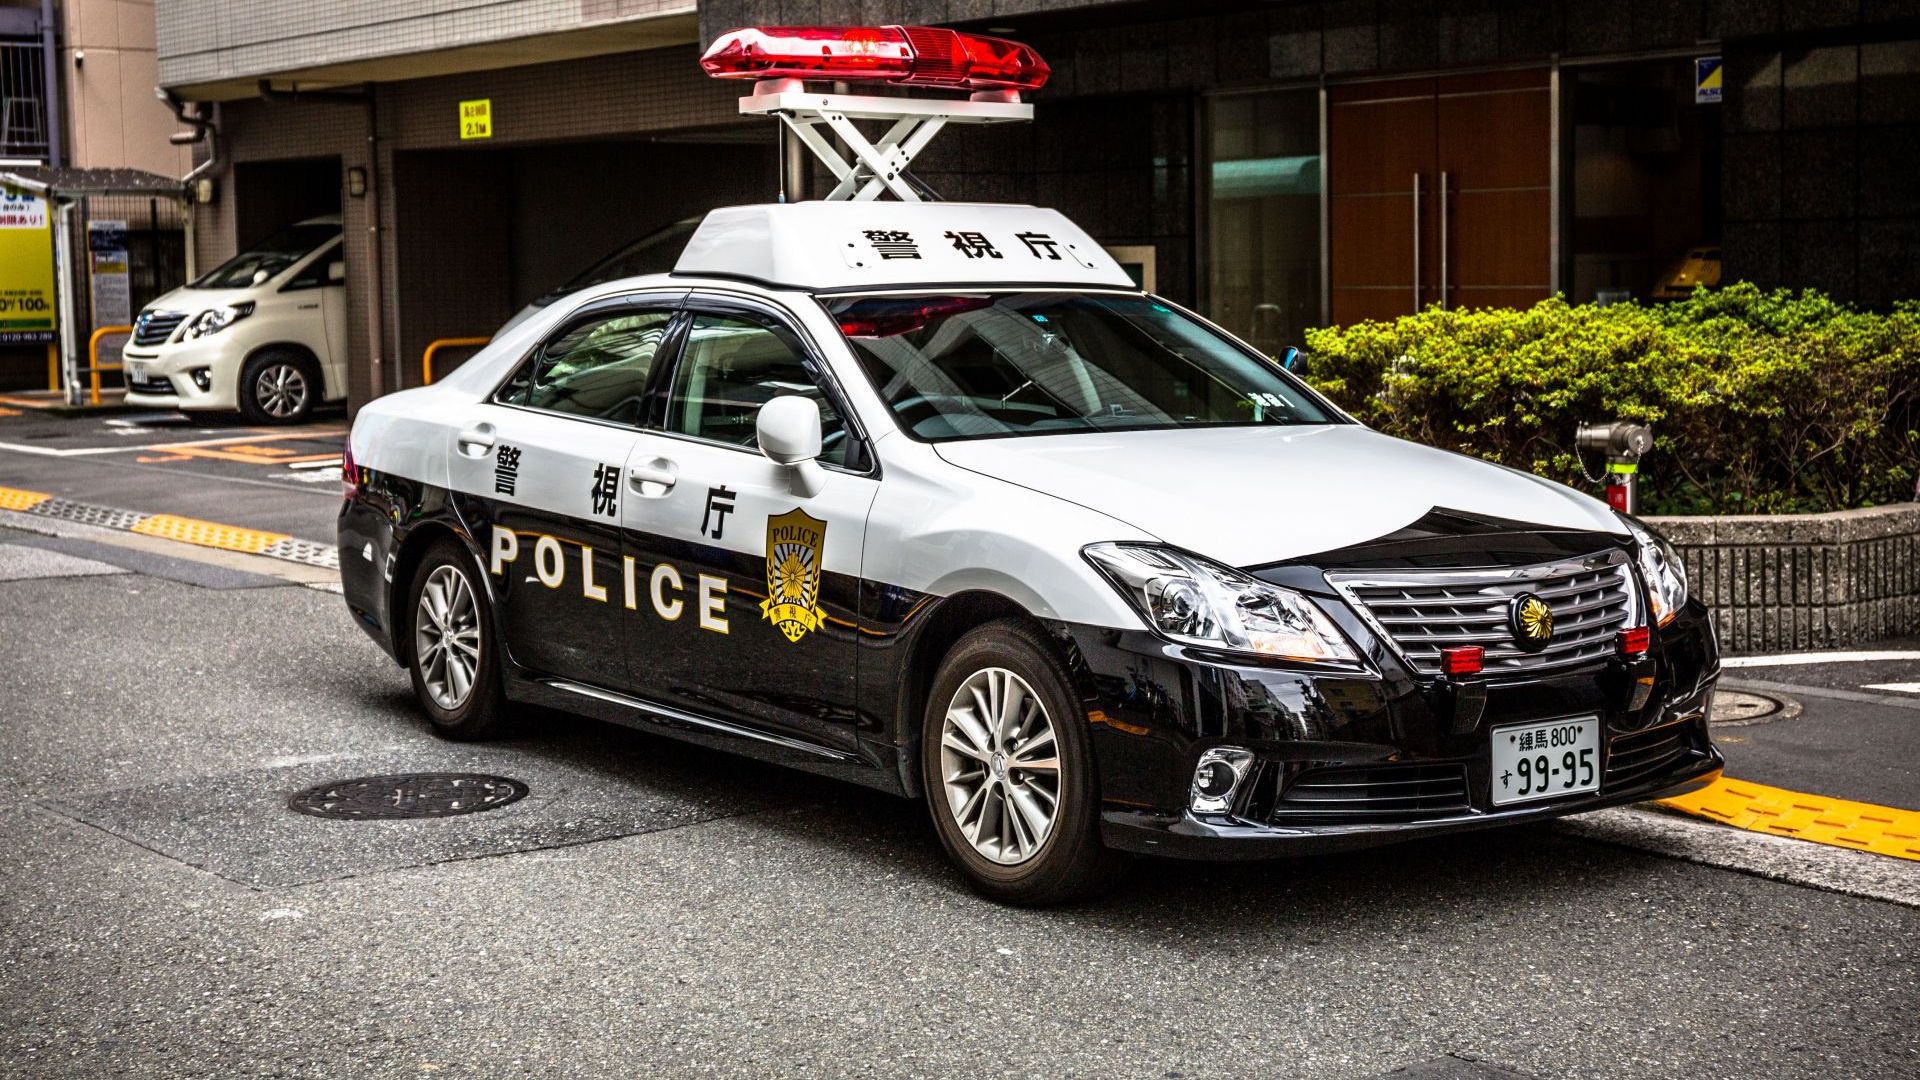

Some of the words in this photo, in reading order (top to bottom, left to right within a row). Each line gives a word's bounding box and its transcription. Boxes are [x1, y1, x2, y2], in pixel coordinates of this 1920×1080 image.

[862, 230, 1062, 260] 警視庁
[494, 444, 737, 540] 警視庁
[772, 525, 819, 548] POLICE
[491, 524, 730, 635] POLICE
[1519, 729, 1548, 752] 練馬
[1550, 725, 1576, 747] 800
[1500, 769, 1513, 789] す
[1517, 747, 1594, 795] 99-95
